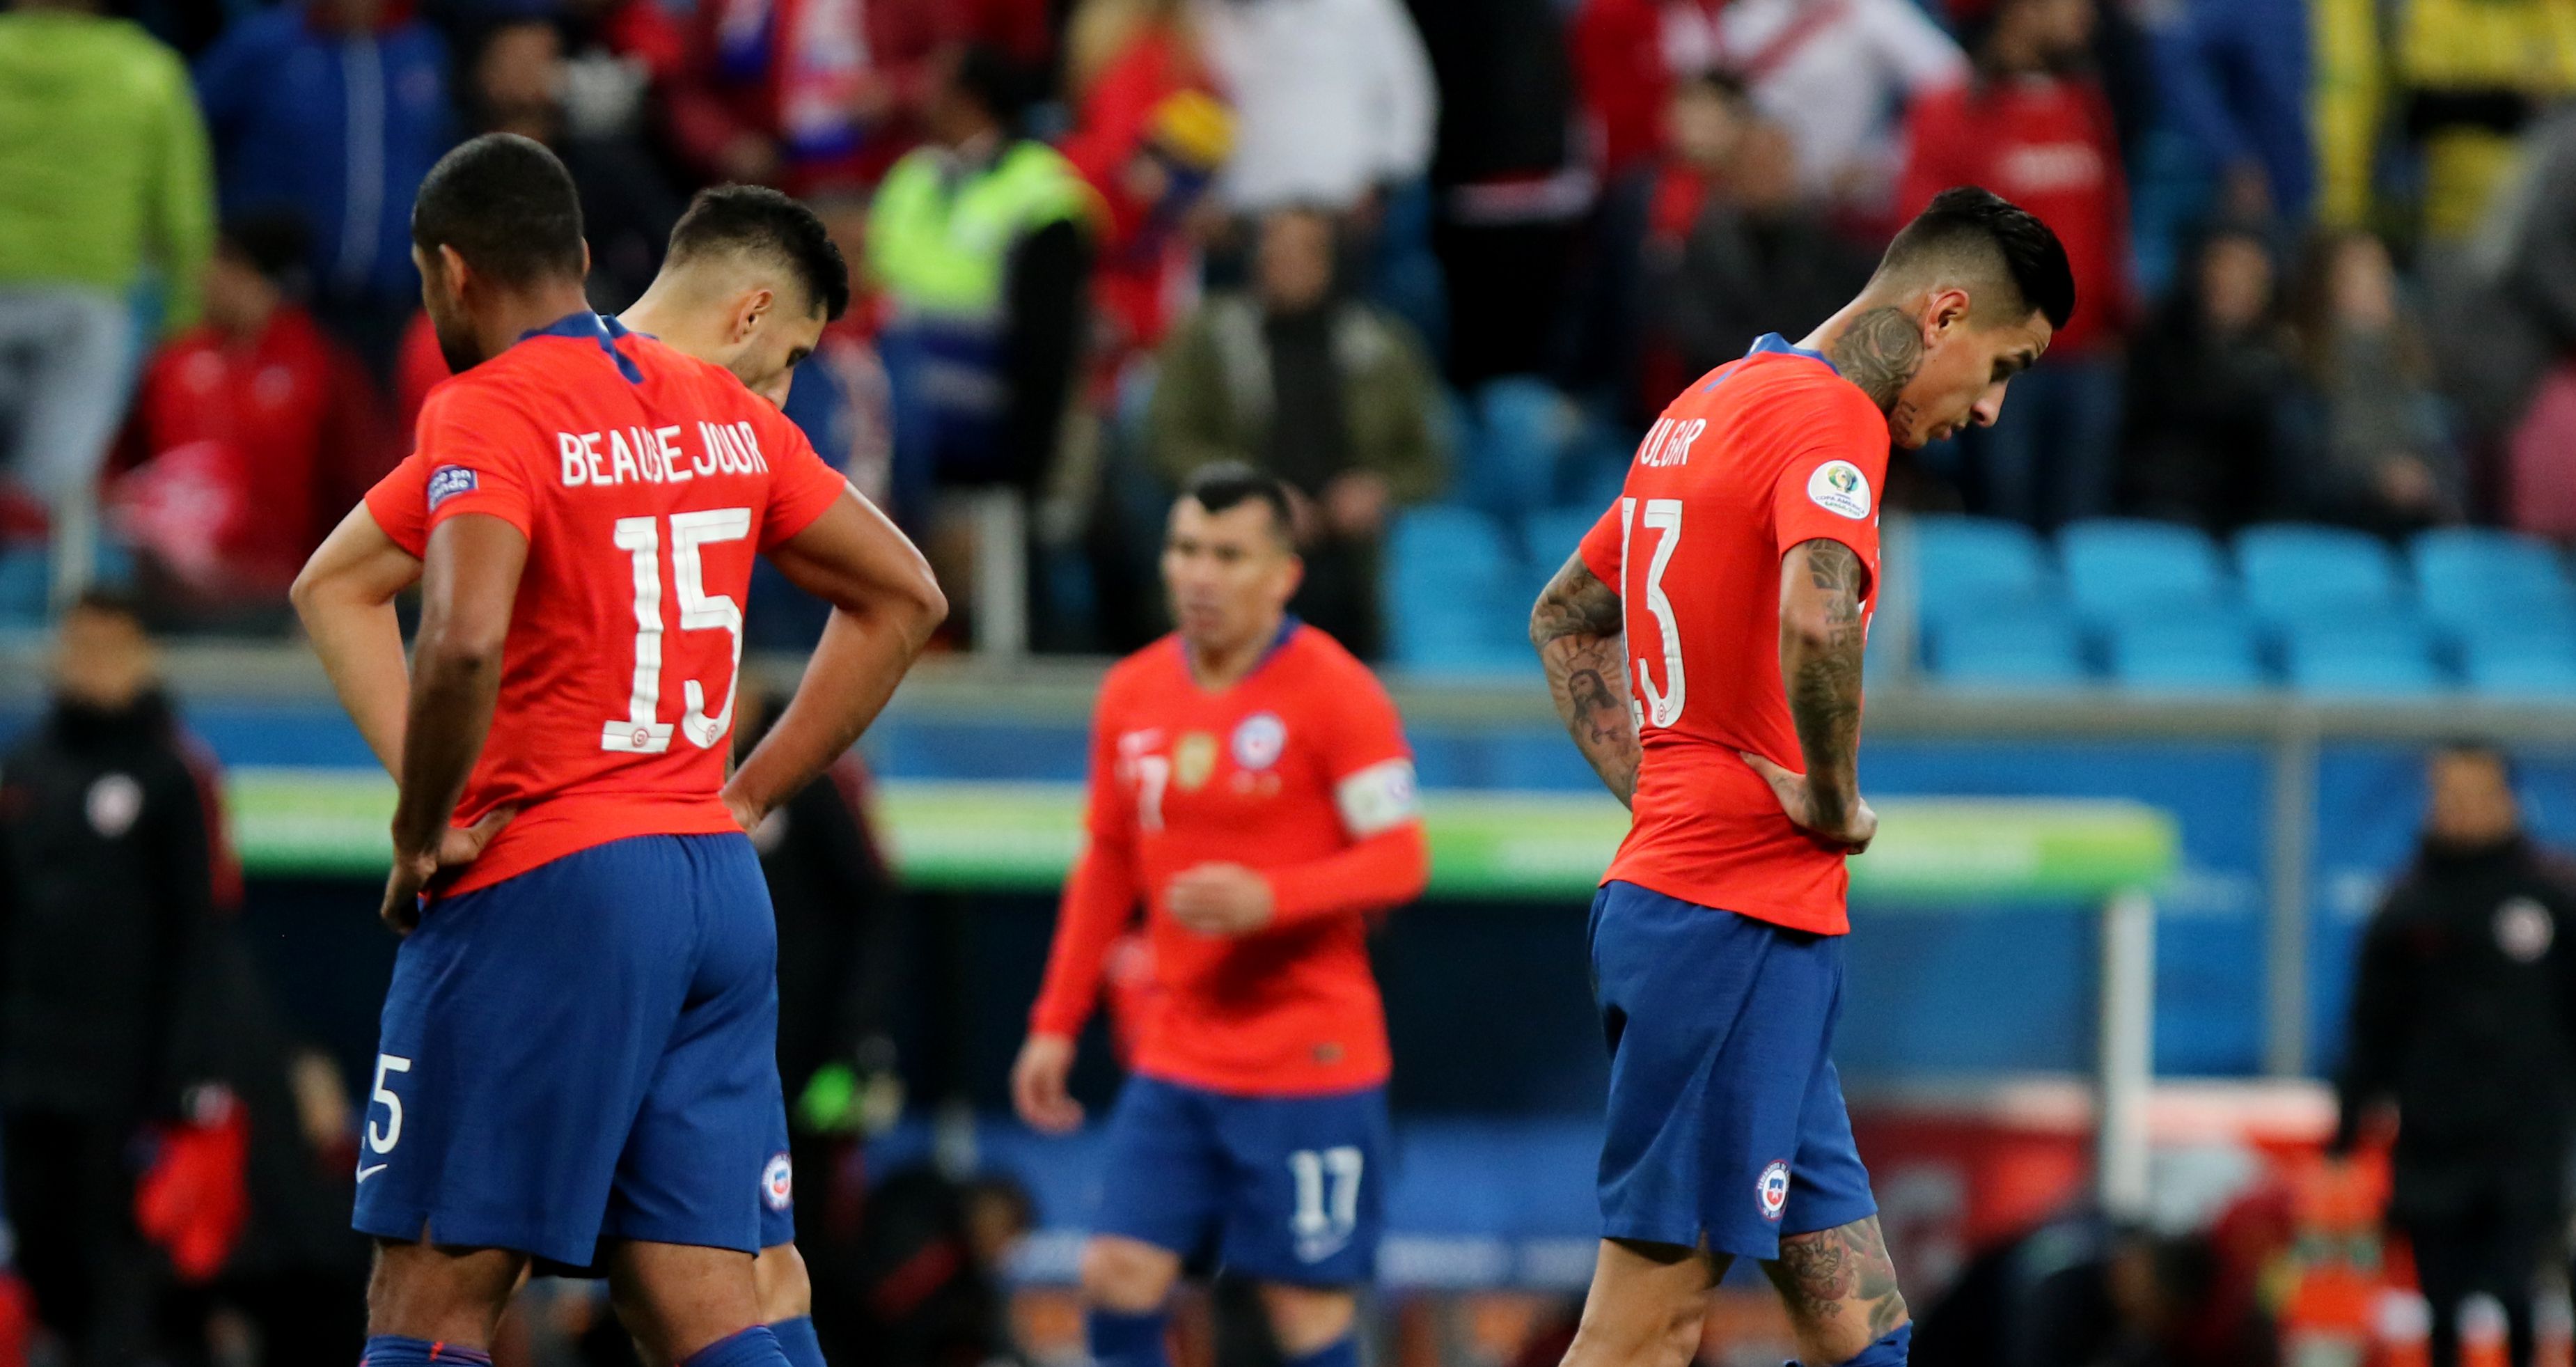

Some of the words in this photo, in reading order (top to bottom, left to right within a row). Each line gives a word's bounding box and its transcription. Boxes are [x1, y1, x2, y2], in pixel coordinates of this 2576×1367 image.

[1641, 417, 1707, 467] ULGAR
[601, 507, 752, 753] 15
[361, 1053, 411, 1155] 5
[1289, 1146, 1364, 1235] 17
